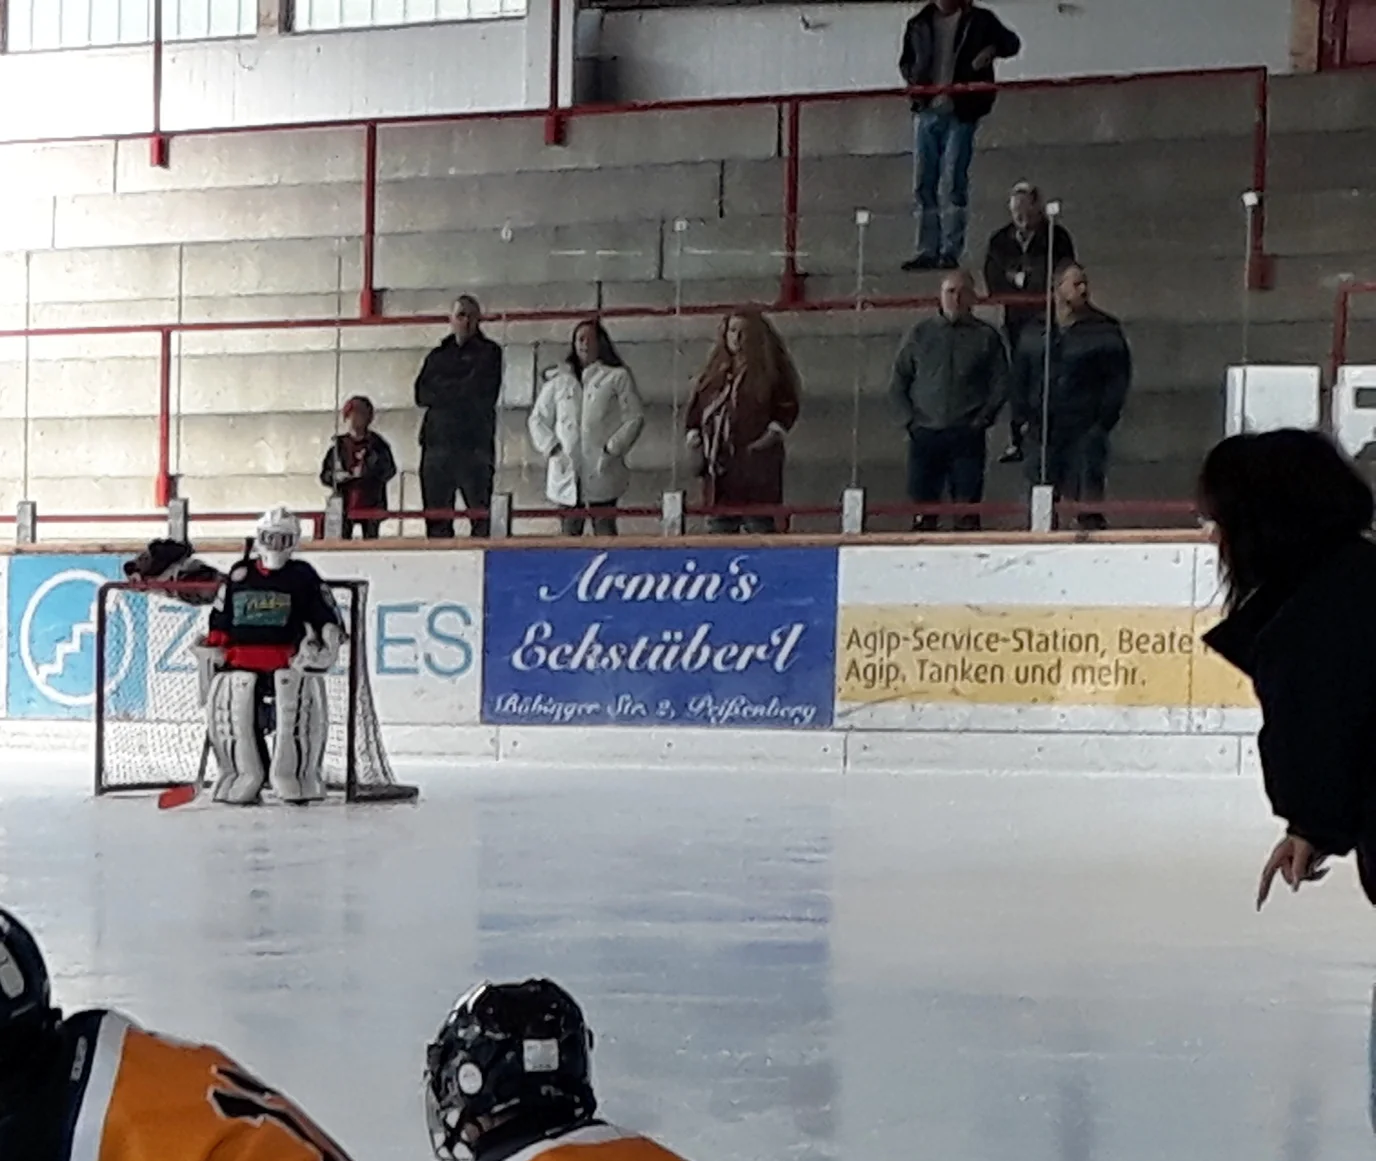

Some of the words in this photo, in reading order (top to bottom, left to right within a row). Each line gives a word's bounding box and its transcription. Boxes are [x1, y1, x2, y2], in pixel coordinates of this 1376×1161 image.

[511, 621, 805, 674] Eckstüberl
[846, 624, 1108, 660] Agip-Service-Station,
[1118, 626, 1194, 656] Beate
[917, 656, 1004, 684] Tanken
[1013, 656, 1063, 685] und
[1070, 658, 1147, 687] mehr.
